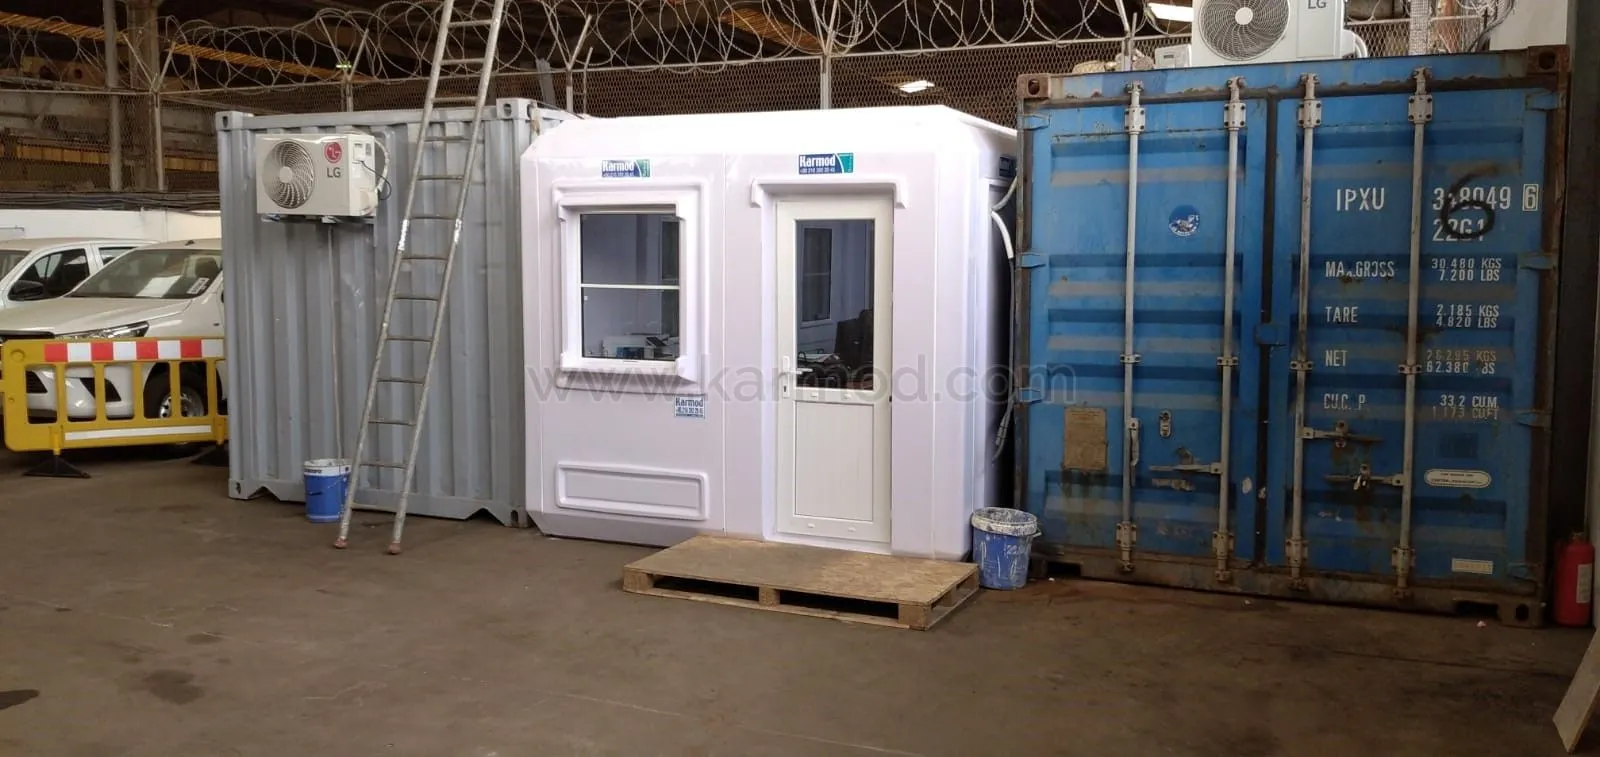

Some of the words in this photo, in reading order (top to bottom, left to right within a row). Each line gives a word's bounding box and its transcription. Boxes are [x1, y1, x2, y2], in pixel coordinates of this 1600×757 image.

[1308, 0, 1327, 9] LG
[799, 154, 836, 167] Karmod
[326, 167, 341, 178] LG
[1336, 187, 1385, 211] IPXU
[1524, 184, 1538, 211] 6
[1431, 257, 1475, 269] 30.480
[1481, 257, 1502, 269] KGS
[1480, 269, 1500, 281] LBS
[1325, 306, 1359, 323] TARE
[1436, 304, 1472, 316] 2.185
[1479, 304, 1499, 317] KGS
[1435, 316, 1472, 328] 4.820
[1477, 317, 1497, 328] LBS
[1325, 350, 1348, 367] NET
[1476, 349, 1496, 362] KGS
[675, 397, 704, 407] Karmod
